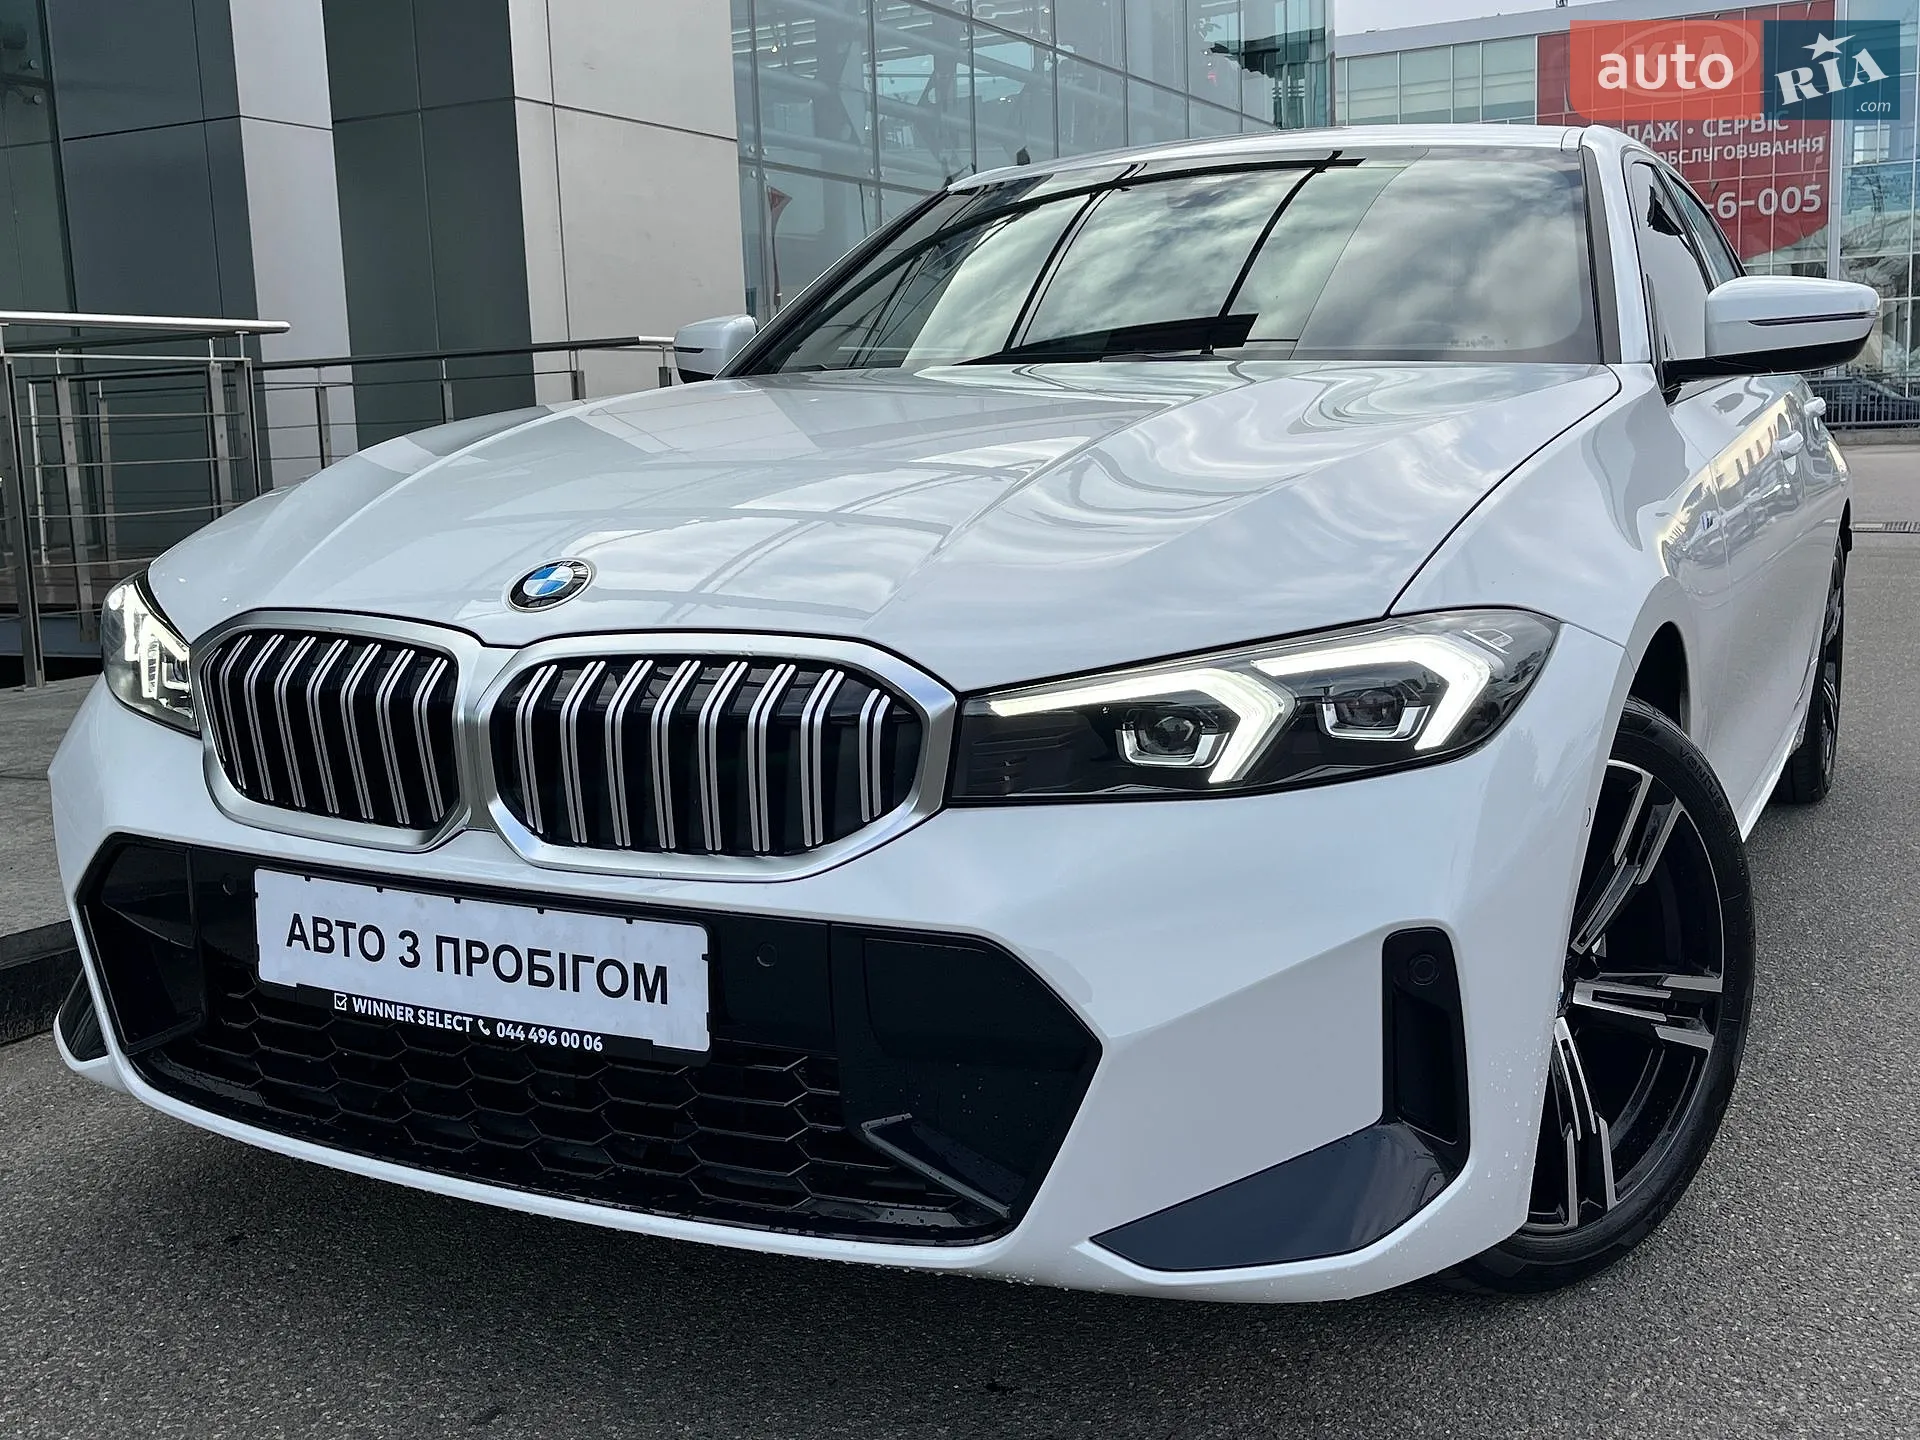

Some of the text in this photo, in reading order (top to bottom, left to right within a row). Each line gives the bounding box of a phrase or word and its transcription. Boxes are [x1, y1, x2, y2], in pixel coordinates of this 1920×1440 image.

[1615, 110, 1789, 144] ДАЖ СЕРВІС
[285, 912, 386, 963] АВТО
[435, 935, 669, 1005] ПРОБІГОМ
[352, 996, 603, 1052] WINNER SELECT 044 496 00 06
